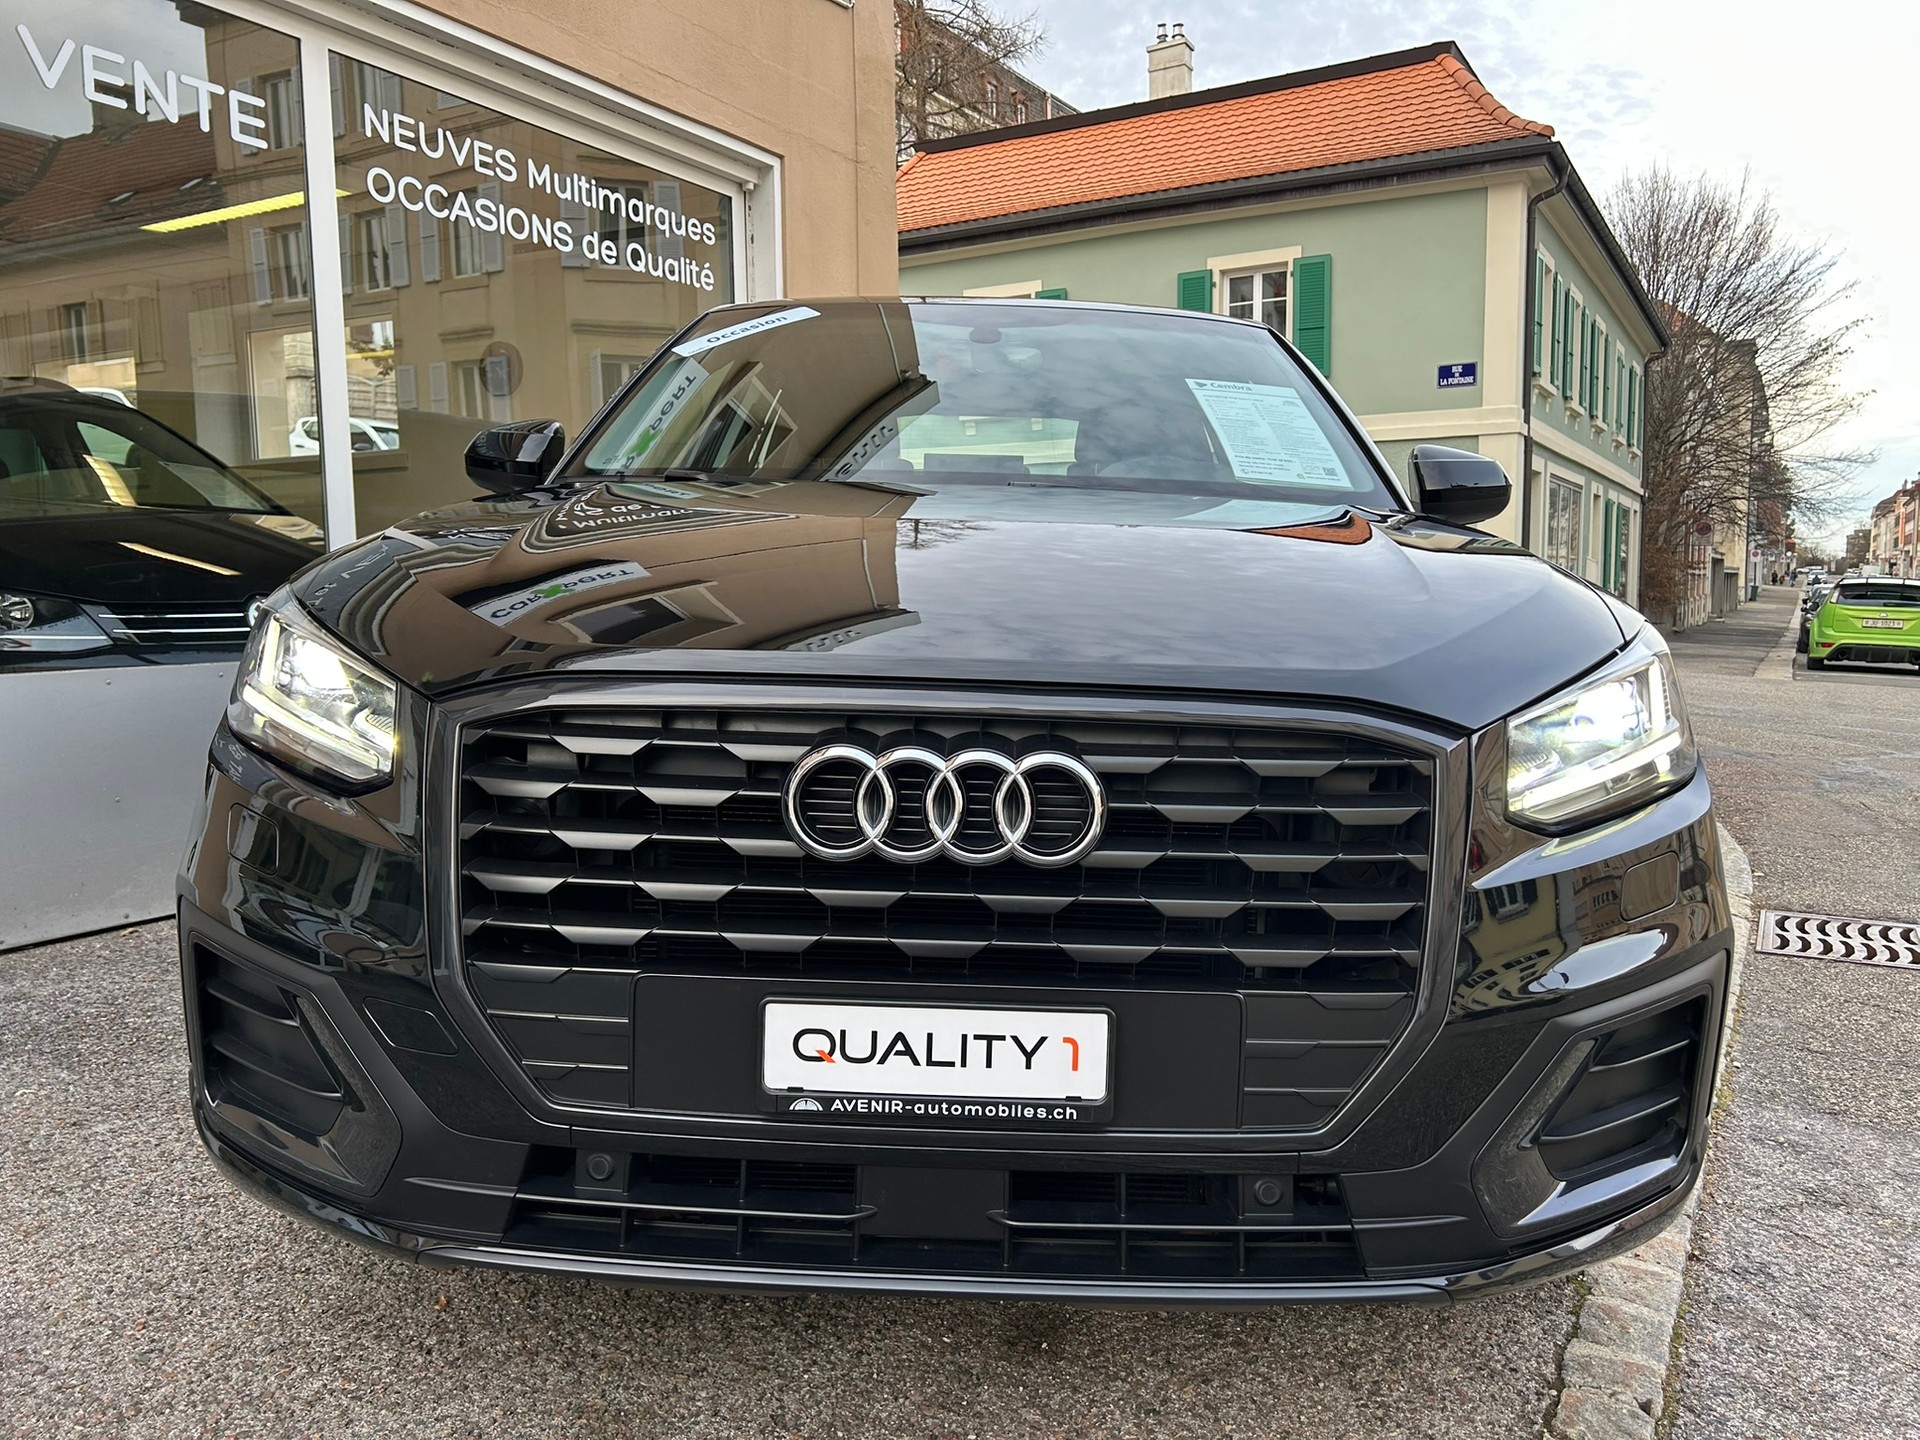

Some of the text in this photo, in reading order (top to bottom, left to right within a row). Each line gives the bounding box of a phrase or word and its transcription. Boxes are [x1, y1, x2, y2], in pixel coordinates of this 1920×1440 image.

[16, 24, 268, 149] VENTE
[364, 102, 716, 246] NEUVES Multimarques
[366, 166, 715, 291] OCCASIONS de Qualité
[706, 315, 788, 343] Occasion
[1210, 382, 1253, 391] Cembra
[1440, 378, 1448, 386] LA
[792, 1028, 1080, 1072] QUALITY 1
[830, 1098, 1078, 1120] AVENIR-automobiles.ch
